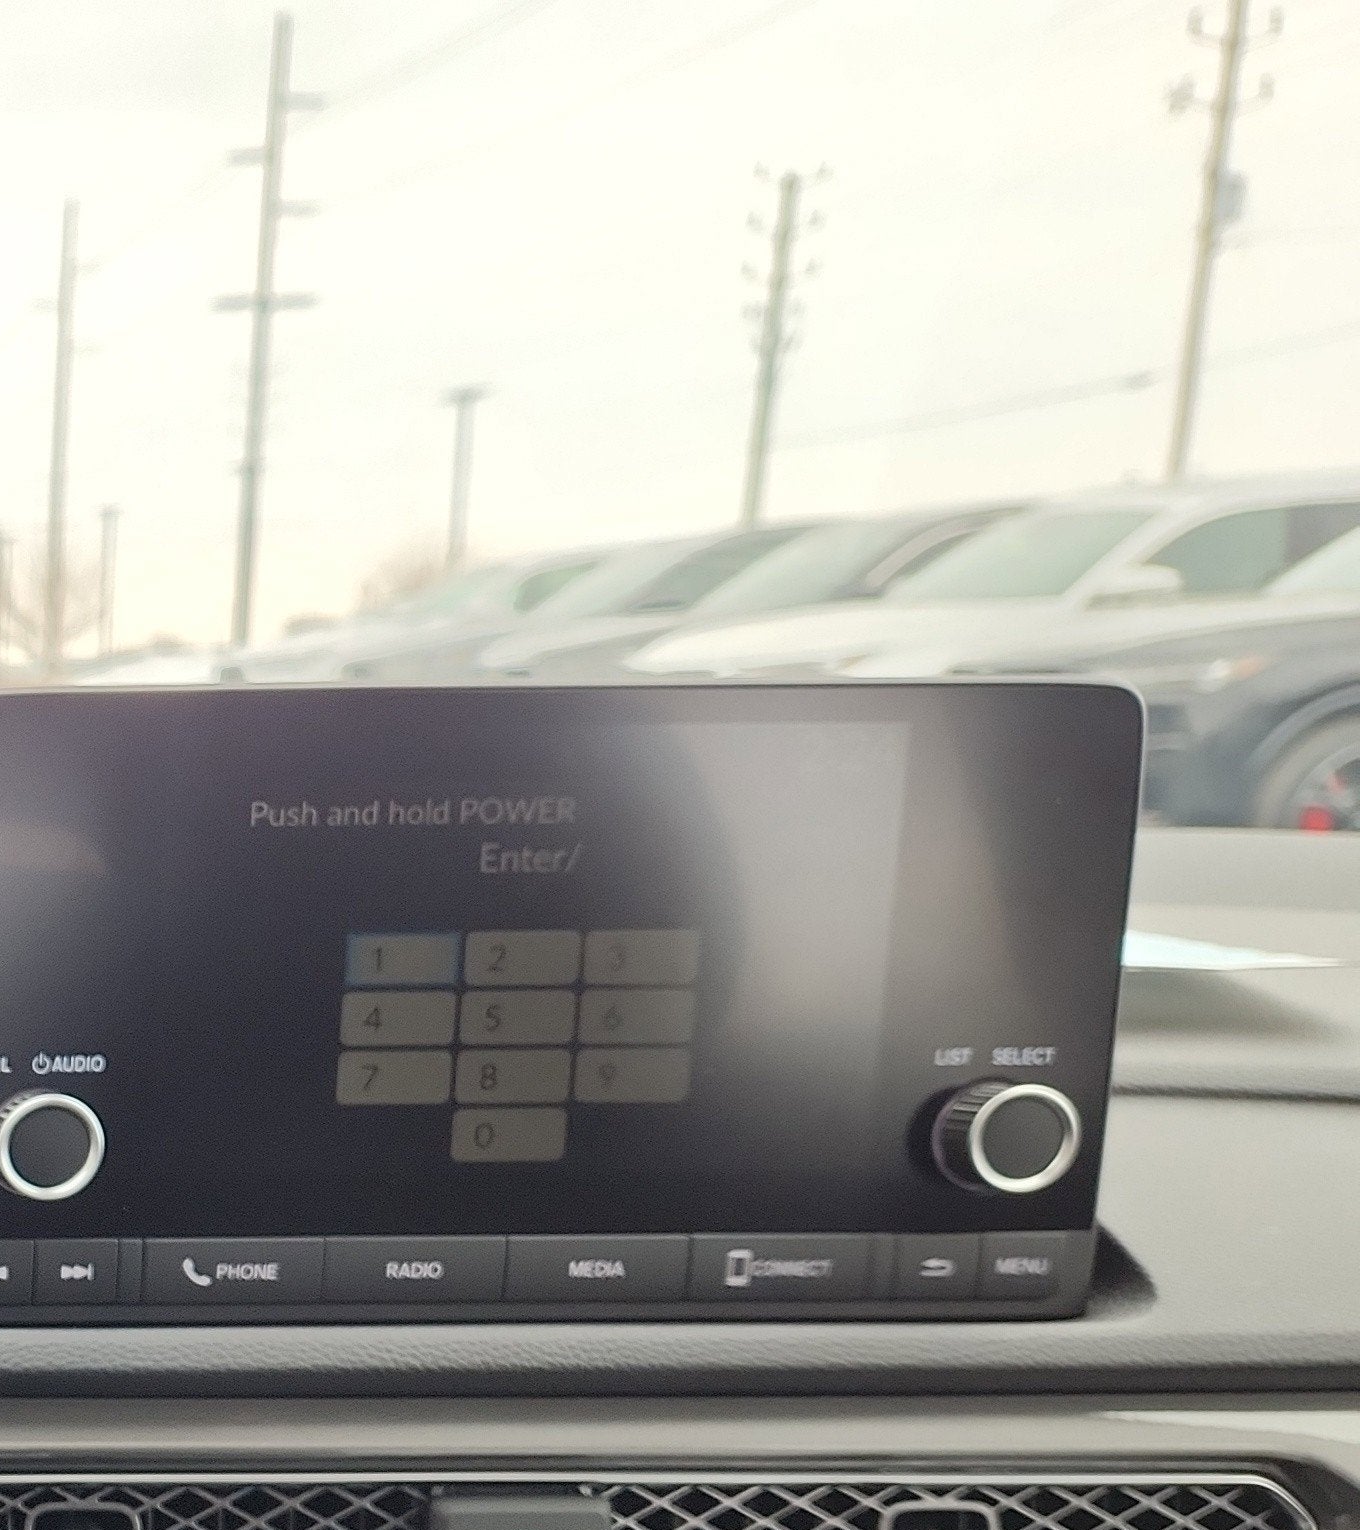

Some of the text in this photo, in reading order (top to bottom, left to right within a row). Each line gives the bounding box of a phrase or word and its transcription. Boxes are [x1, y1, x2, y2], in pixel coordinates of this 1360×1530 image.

[250, 799, 575, 828] Push and hold POWER
[372, 946, 384, 972] 1
[488, 945, 507, 973] 2
[610, 945, 626, 973] 3
[363, 1006, 382, 1032] 4
[484, 1005, 502, 1032] 5
[604, 1004, 623, 1031] 6
[51, 1054, 107, 1074] AUDIO
[992, 1046, 1056, 1066] SELECT
[361, 1063, 379, 1090] 7
[480, 1063, 498, 1091] 8
[598, 1062, 616, 1089] 9
[474, 1122, 494, 1150] 0
[216, 1262, 279, 1281] PHONE
[386, 1261, 443, 1280] RADIO
[568, 1259, 625, 1279] MEDIA
[995, 1257, 1051, 1276] MENU
